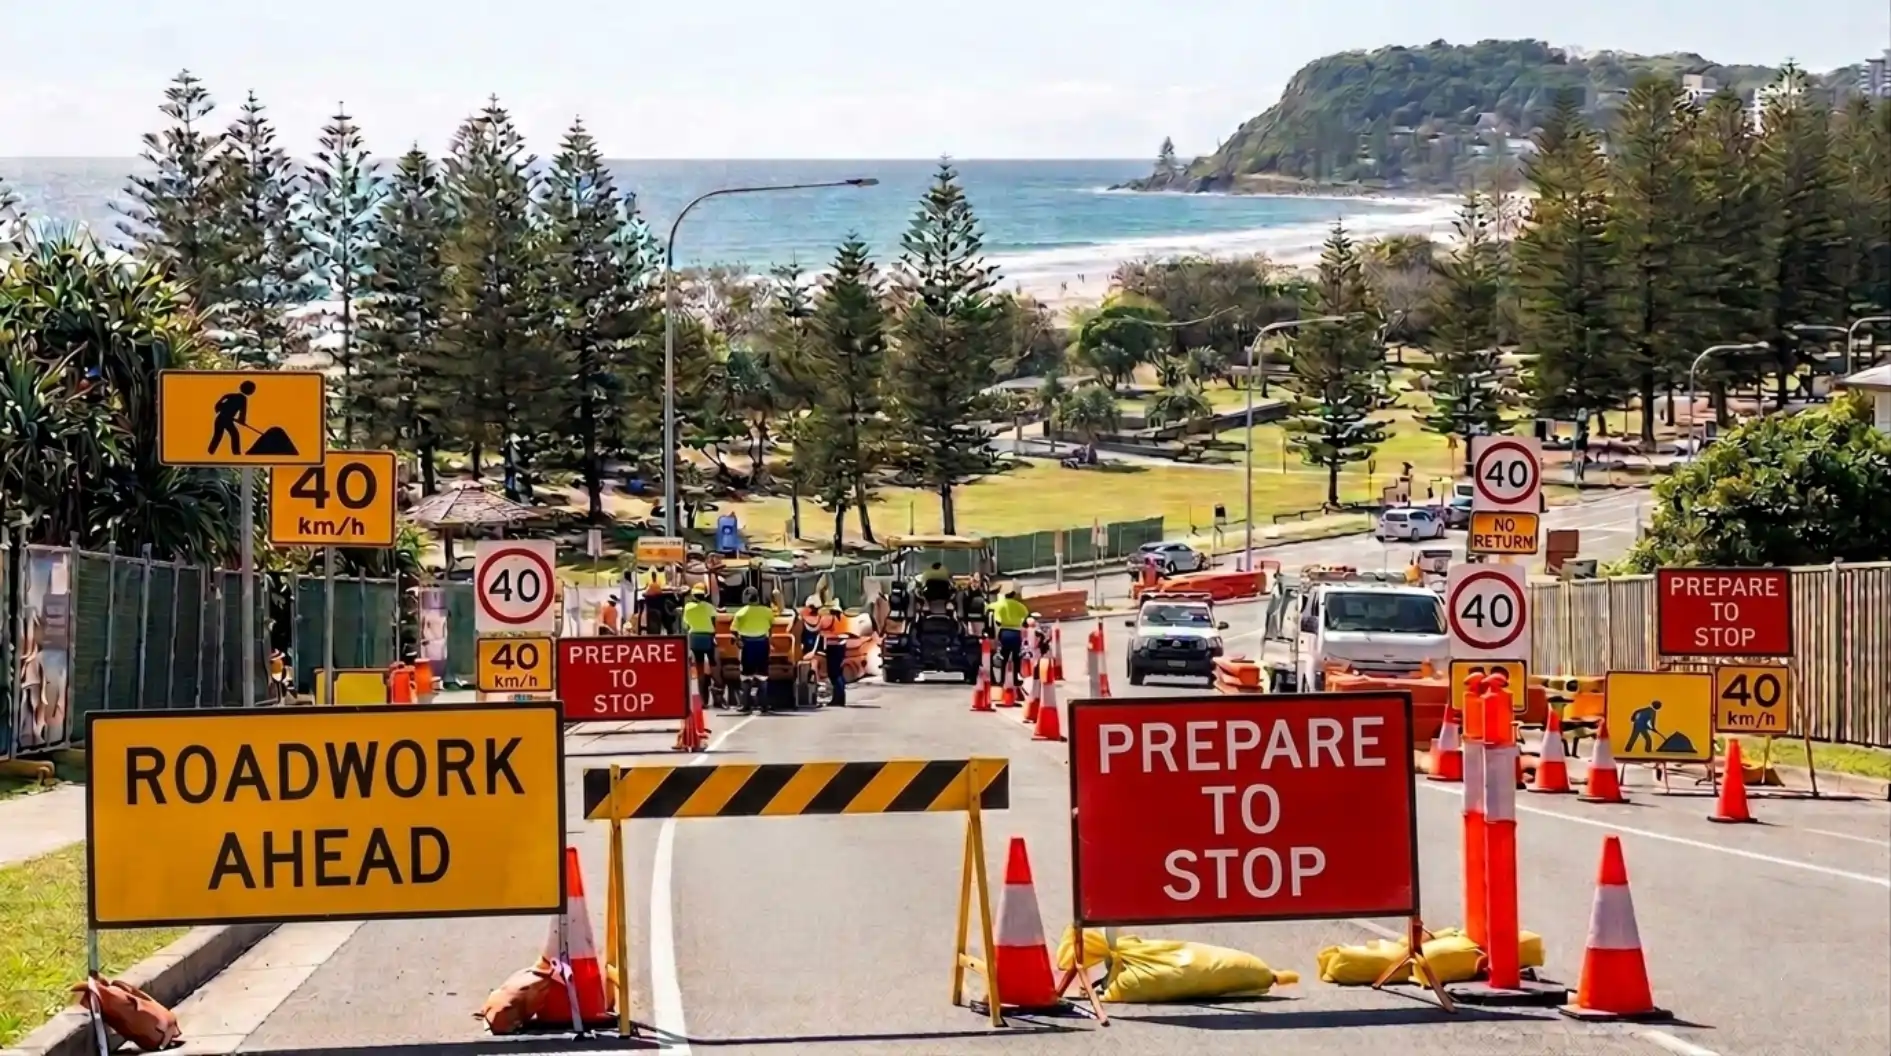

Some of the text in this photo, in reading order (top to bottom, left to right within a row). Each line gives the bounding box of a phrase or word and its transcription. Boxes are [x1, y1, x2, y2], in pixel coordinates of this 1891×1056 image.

[290, 462, 378, 510] 40
[1484, 460, 1528, 489] 40
[298, 516, 365, 536] km/h
[1493, 518, 1516, 533] NO
[1473, 534, 1534, 550] RETURN
[489, 568, 541, 603] 40
[1671, 577, 1779, 598] PREPARE
[1461, 593, 1514, 628] 40
[1711, 603, 1740, 623] TO
[1696, 628, 1757, 648] STOP
[490, 643, 539, 670] 40
[570, 644, 679, 665] PREPARE
[494, 673, 538, 688] km/h
[609, 670, 638, 689] TO
[1722, 673, 1782, 708] 40
[594, 694, 655, 714] STOP
[1100, 717, 1387, 775] PREPARE
[126, 737, 527, 806] ROADWORK
[1201, 784, 1282, 836] TO
[208, 827, 452, 891] AHEAD
[1164, 846, 1328, 902] STOP
